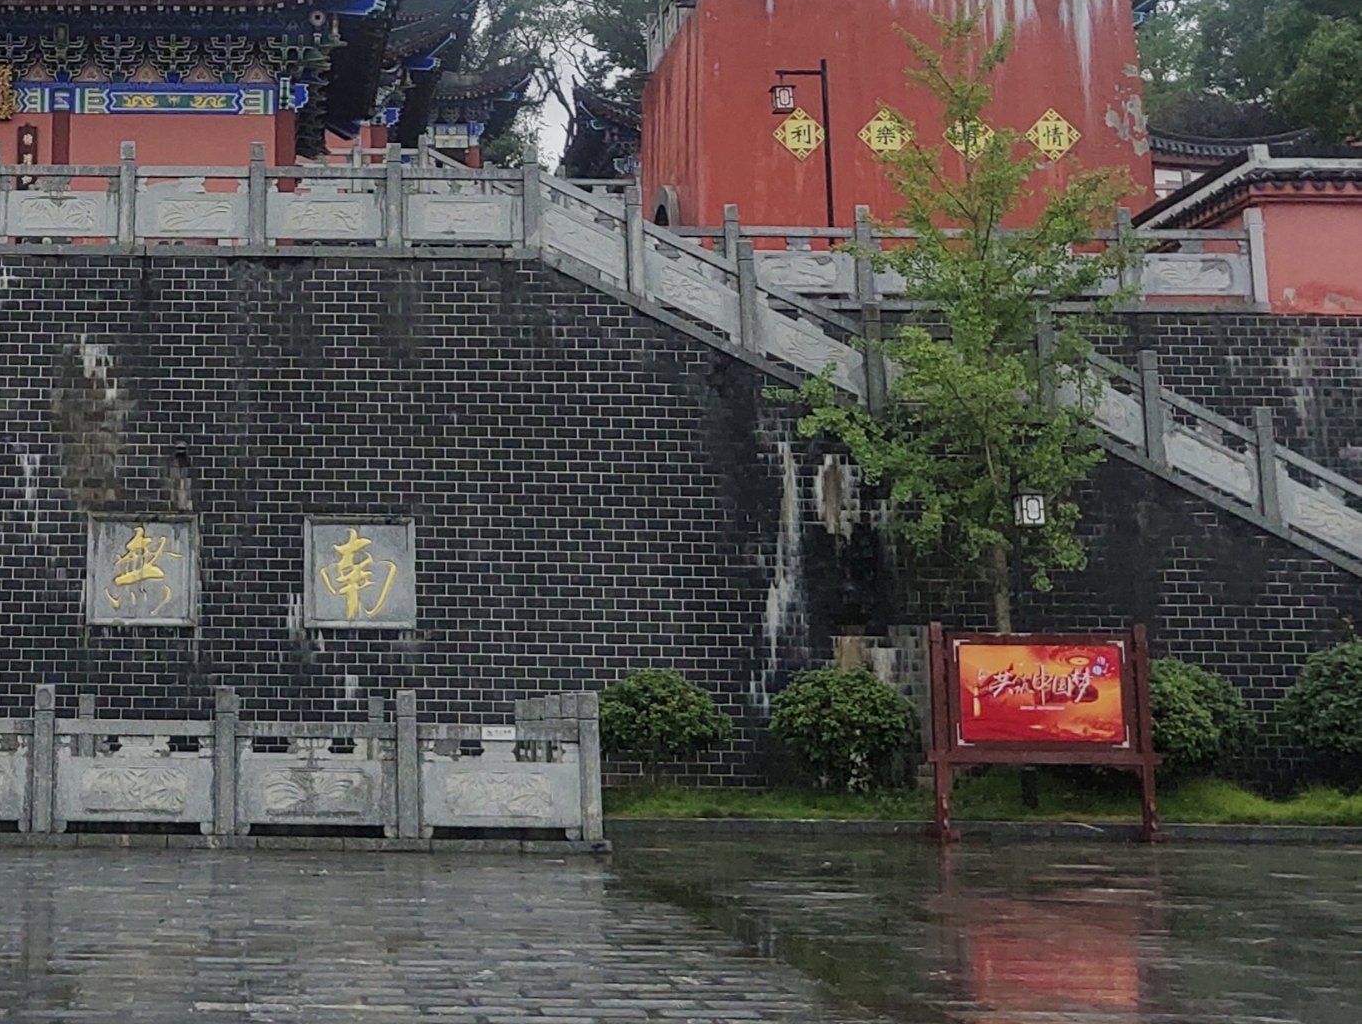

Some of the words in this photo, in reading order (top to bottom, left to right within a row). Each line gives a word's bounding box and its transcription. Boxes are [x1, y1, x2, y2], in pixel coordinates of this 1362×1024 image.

[790, 123, 812, 145] 利
[1041, 123, 1065, 147] 情
[320, 526, 397, 621] 南
